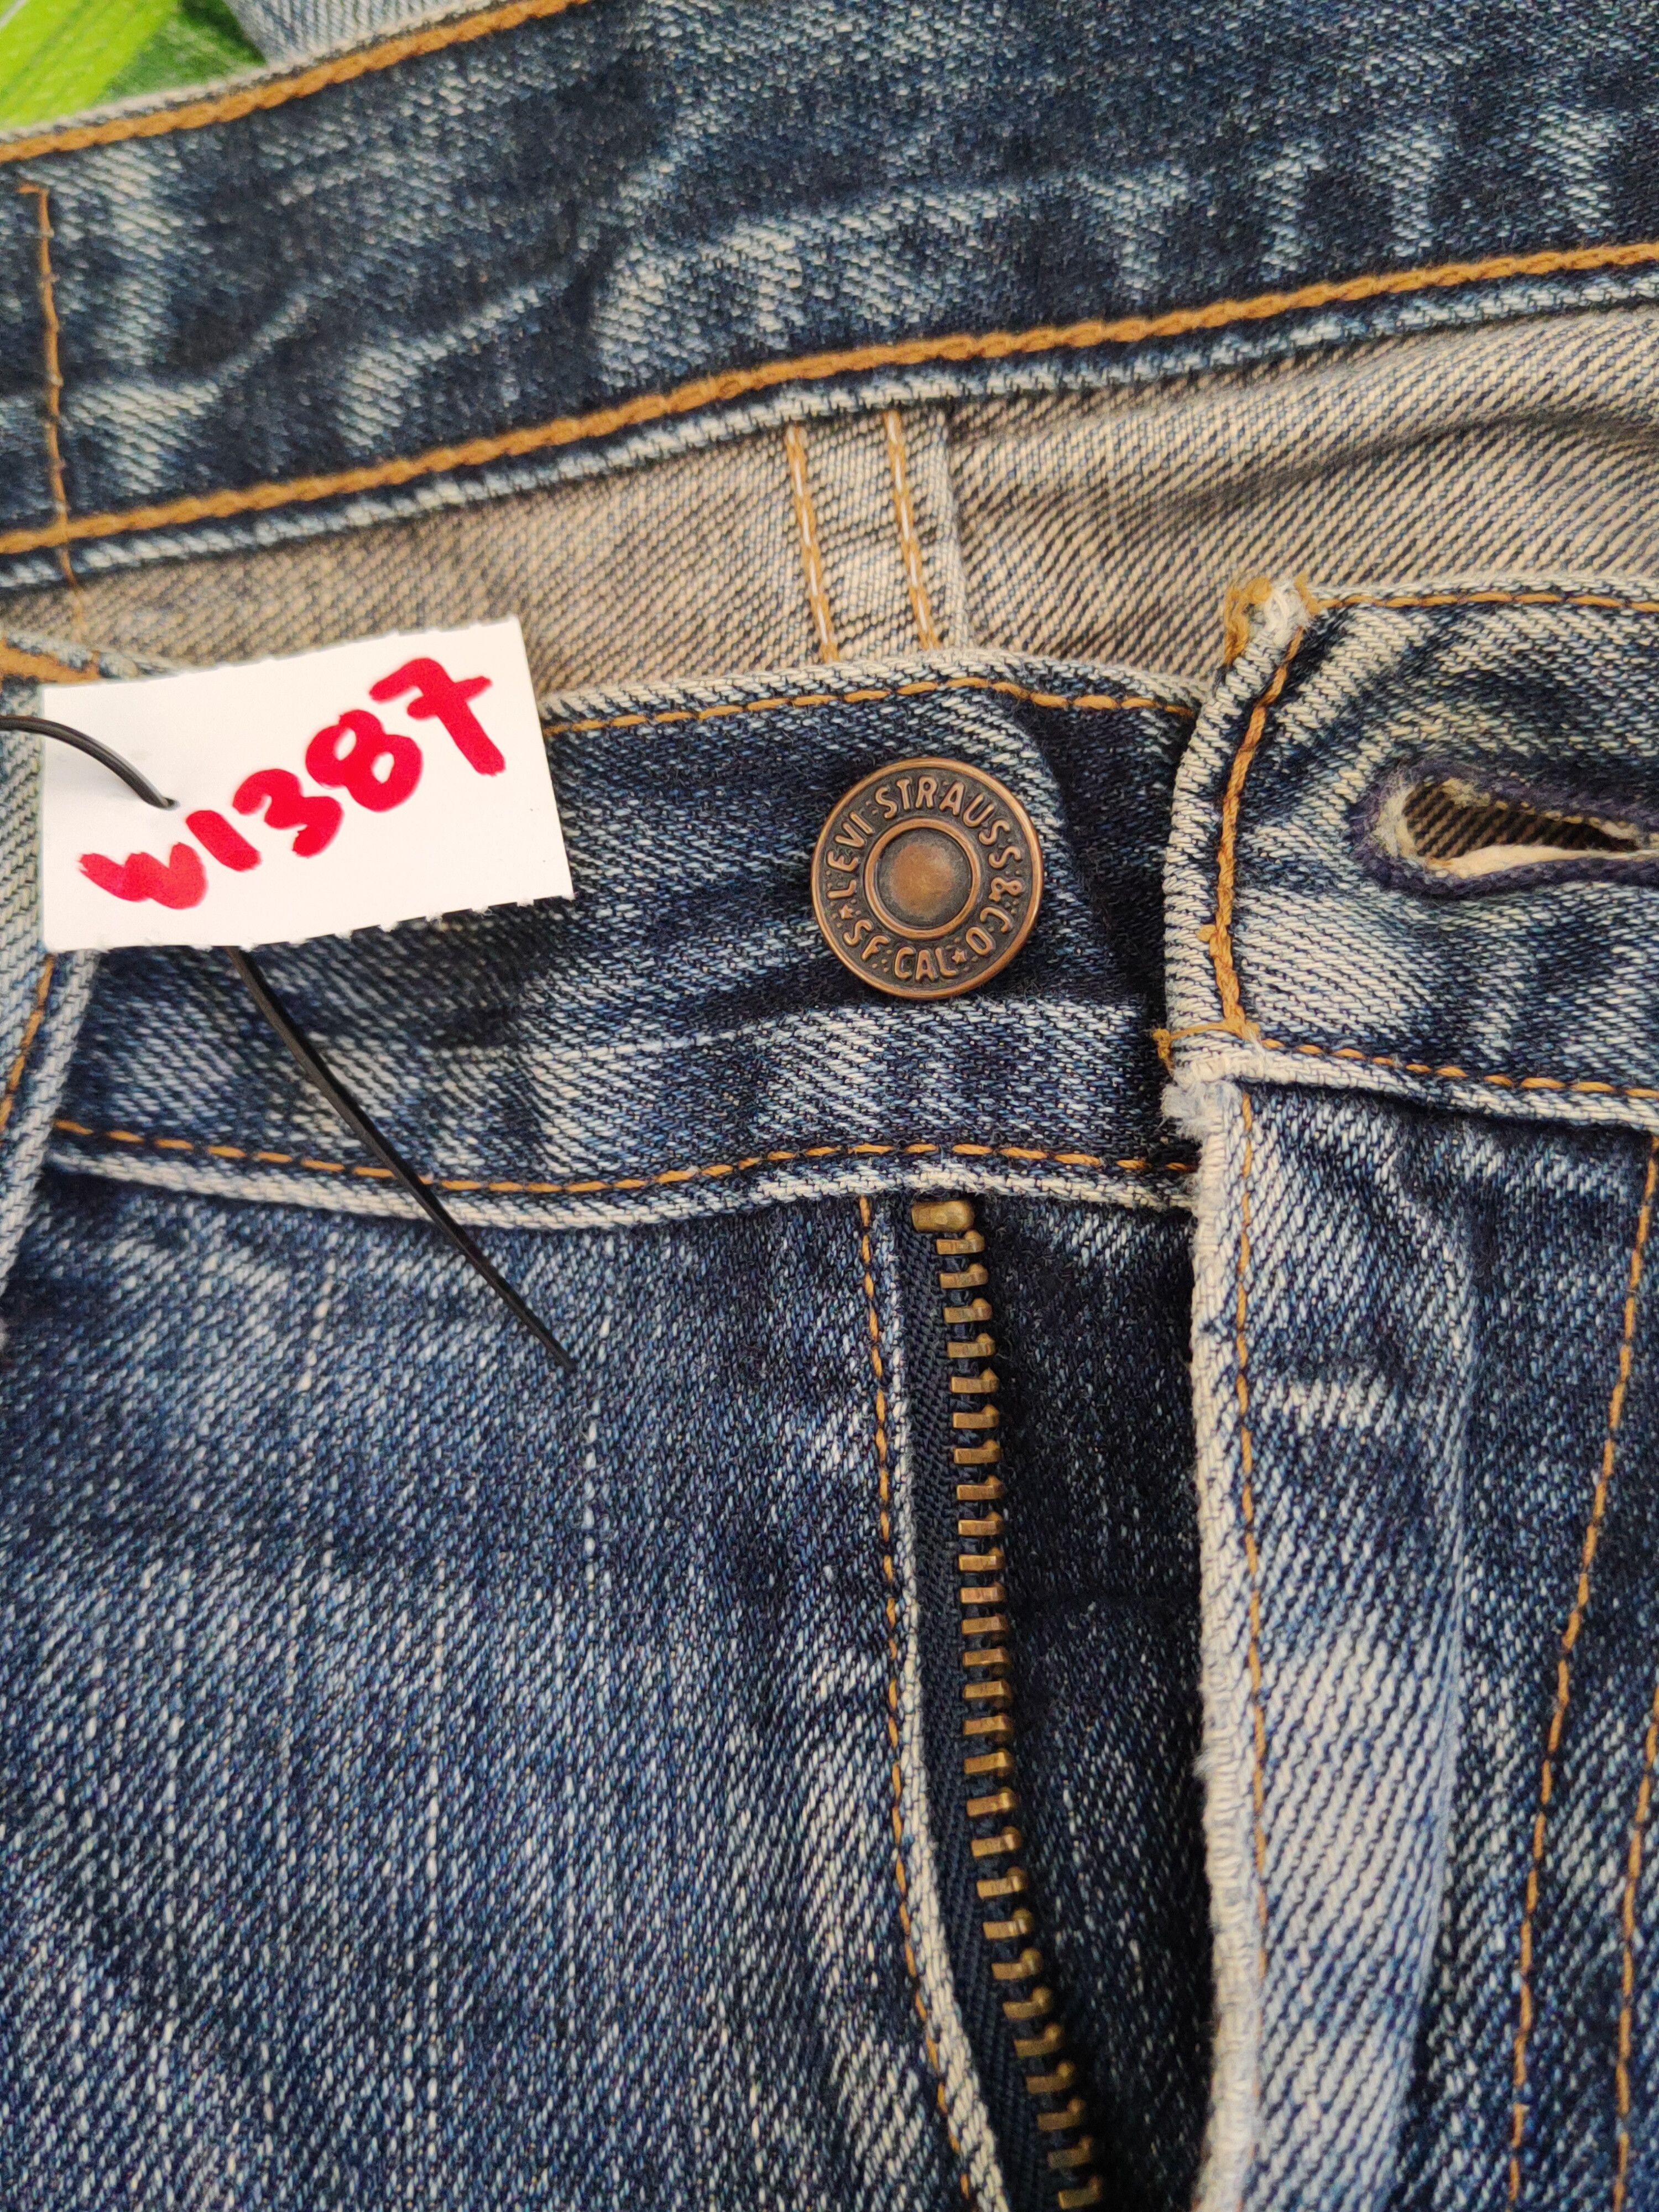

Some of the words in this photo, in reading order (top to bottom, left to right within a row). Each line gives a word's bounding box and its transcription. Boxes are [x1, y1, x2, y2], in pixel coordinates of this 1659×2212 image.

[874, 775, 1023, 869] STRAUSS
[826, 811, 874, 900] LEVI
[988, 877, 1024, 902] &
[965, 906, 1013, 956] CO
[893, 946, 957, 983] CAL
